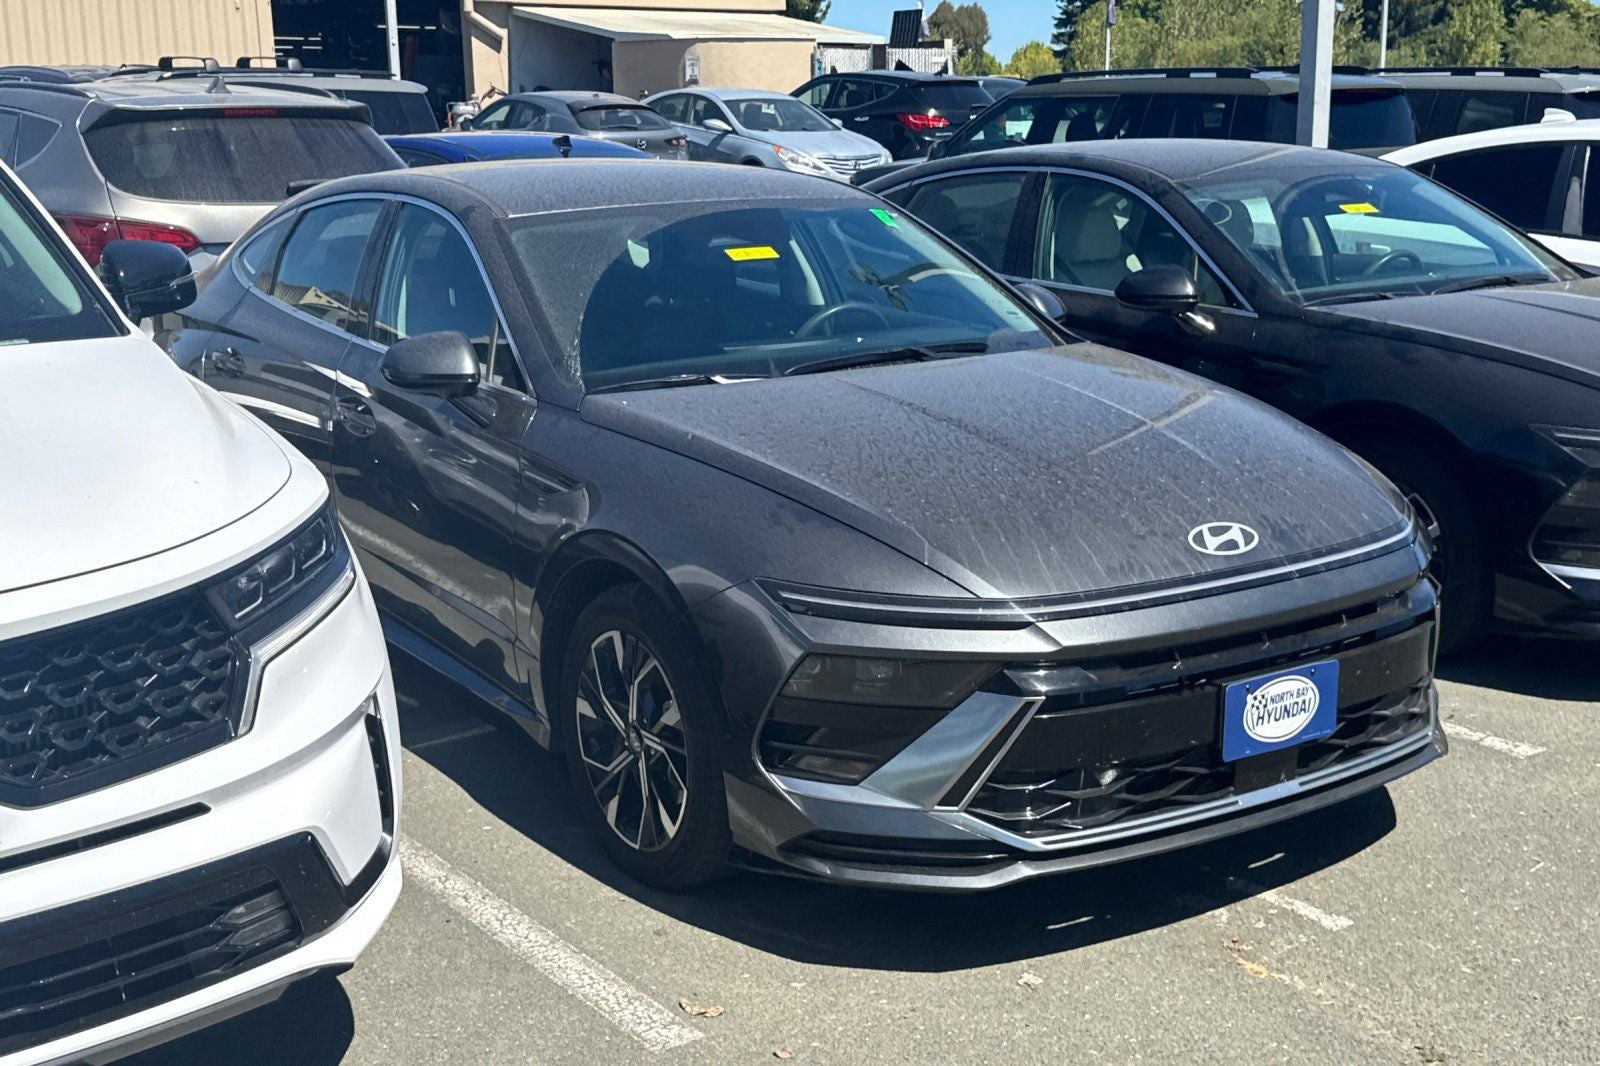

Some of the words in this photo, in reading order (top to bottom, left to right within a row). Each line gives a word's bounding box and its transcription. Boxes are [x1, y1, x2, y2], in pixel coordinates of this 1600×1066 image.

[1269, 690, 1294, 705] NORTH
[1295, 686, 1310, 698] BAY
[1256, 697, 1312, 726] HYUNDAI
